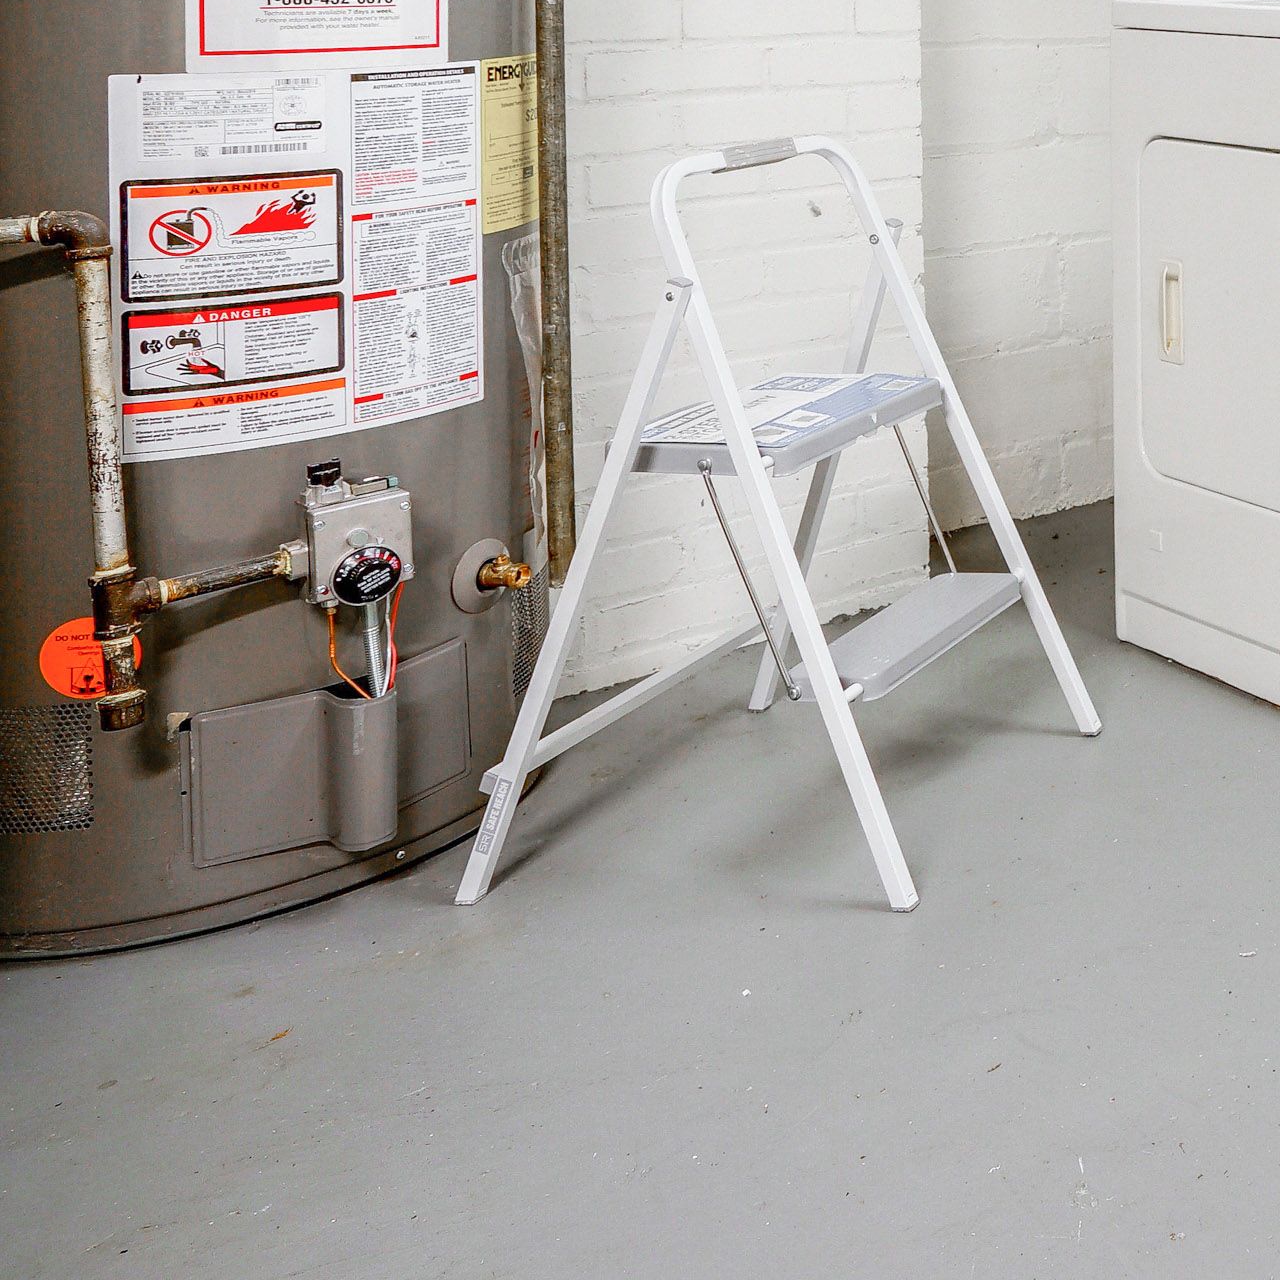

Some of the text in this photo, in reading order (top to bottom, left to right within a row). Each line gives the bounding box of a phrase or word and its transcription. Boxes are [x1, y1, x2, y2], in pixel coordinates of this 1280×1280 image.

[206, 181, 281, 194] WARNING
[231, 235, 298, 245] Flammable Vapors
[219, 253, 257, 262] EXPLOSION
[259, 250, 286, 258] HAZARD
[209, 307, 271, 322] DANGER
[188, 349, 205, 357] HOT
[212, 390, 280, 405] WARNING
[486, 782, 509, 831] SAFE REACH
[479, 834, 492, 853] SR
